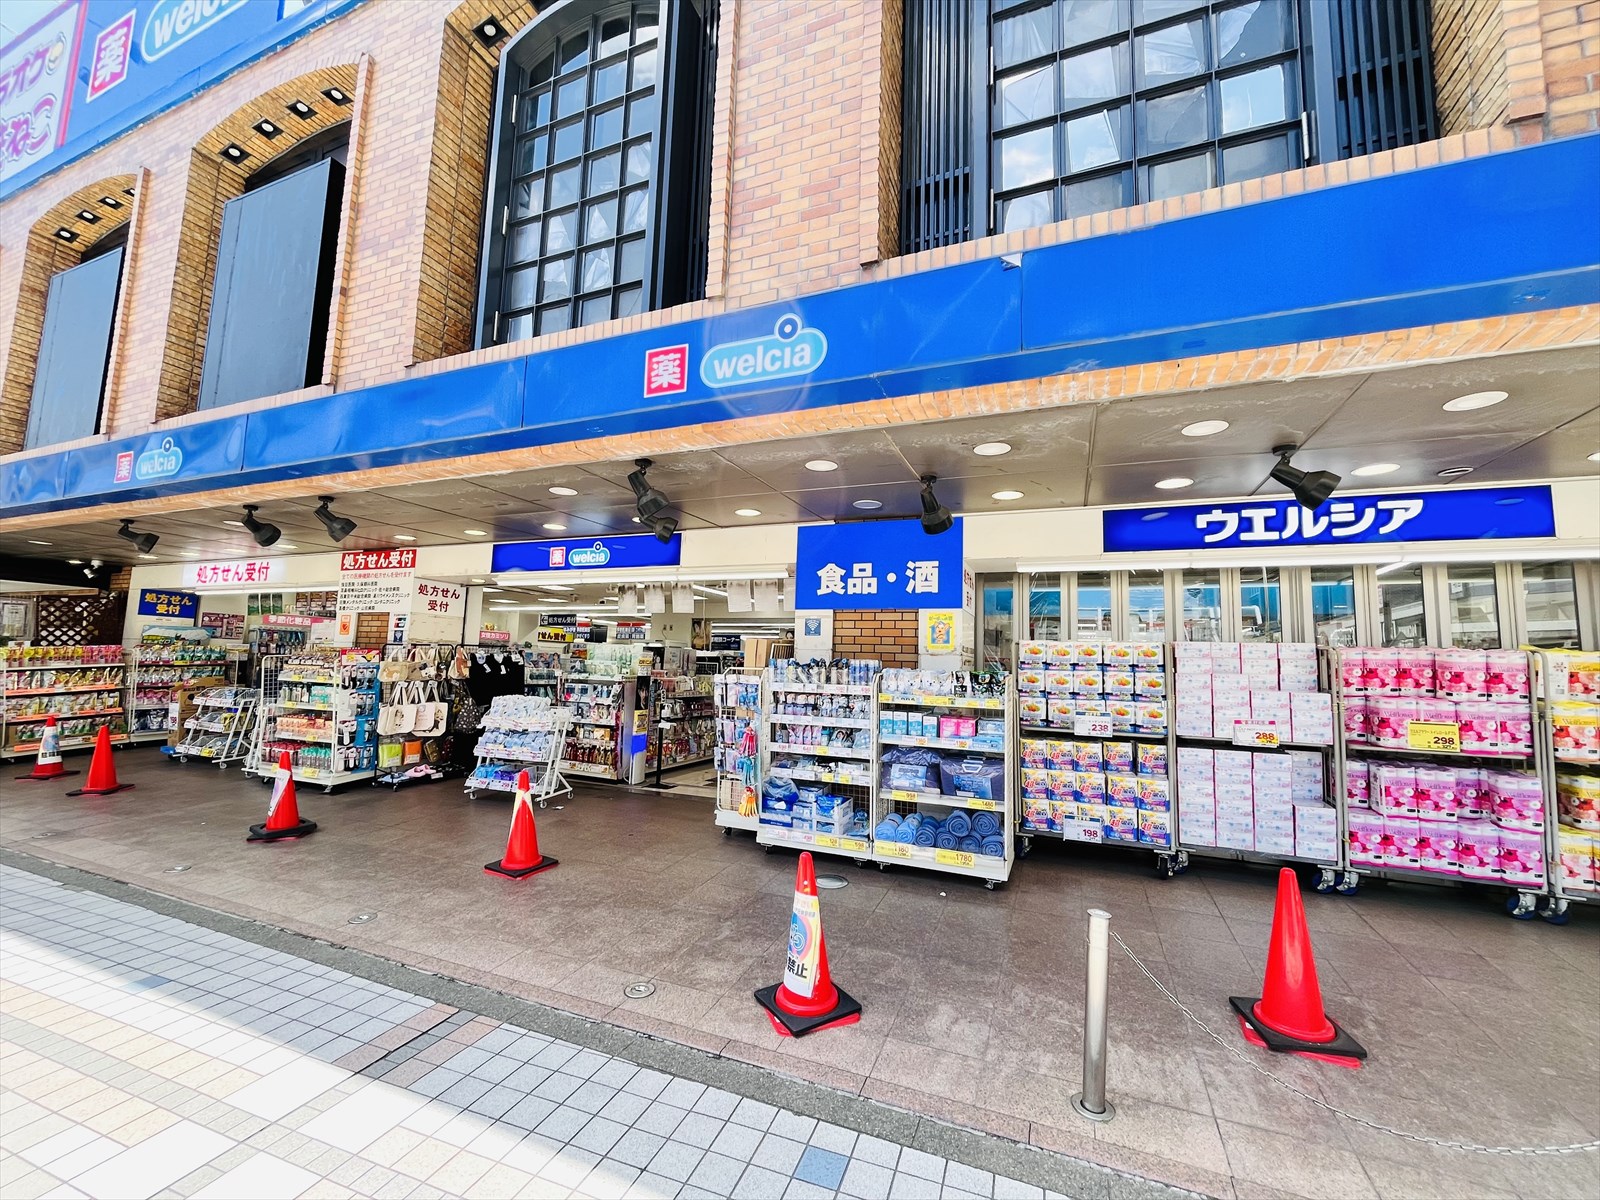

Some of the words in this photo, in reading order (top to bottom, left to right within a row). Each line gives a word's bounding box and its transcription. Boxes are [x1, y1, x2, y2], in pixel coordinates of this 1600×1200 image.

[714, 337, 811, 380] welcia
[650, 352, 682, 389] 薬
[116, 456, 132, 479] 薬
[140, 451, 176, 474] welcia
[1196, 498, 1424, 544] ウエルシア
[343, 551, 414, 569] 処方せん受付
[572, 549, 606, 564] welcia
[196, 562, 271, 584] 処方せん受付
[816, 560, 940, 596] 食品・酒
[144, 592, 193, 606] 処方せん
[417, 583, 461, 600] 処方せん
[156, 604, 181, 615] 受付
[427, 600, 450, 613] 受付
[1091, 723, 1109, 732] 238
[1255, 731, 1275, 741] 288
[1433, 735, 1455, 745] 298
[1082, 828, 1099, 838] 198
